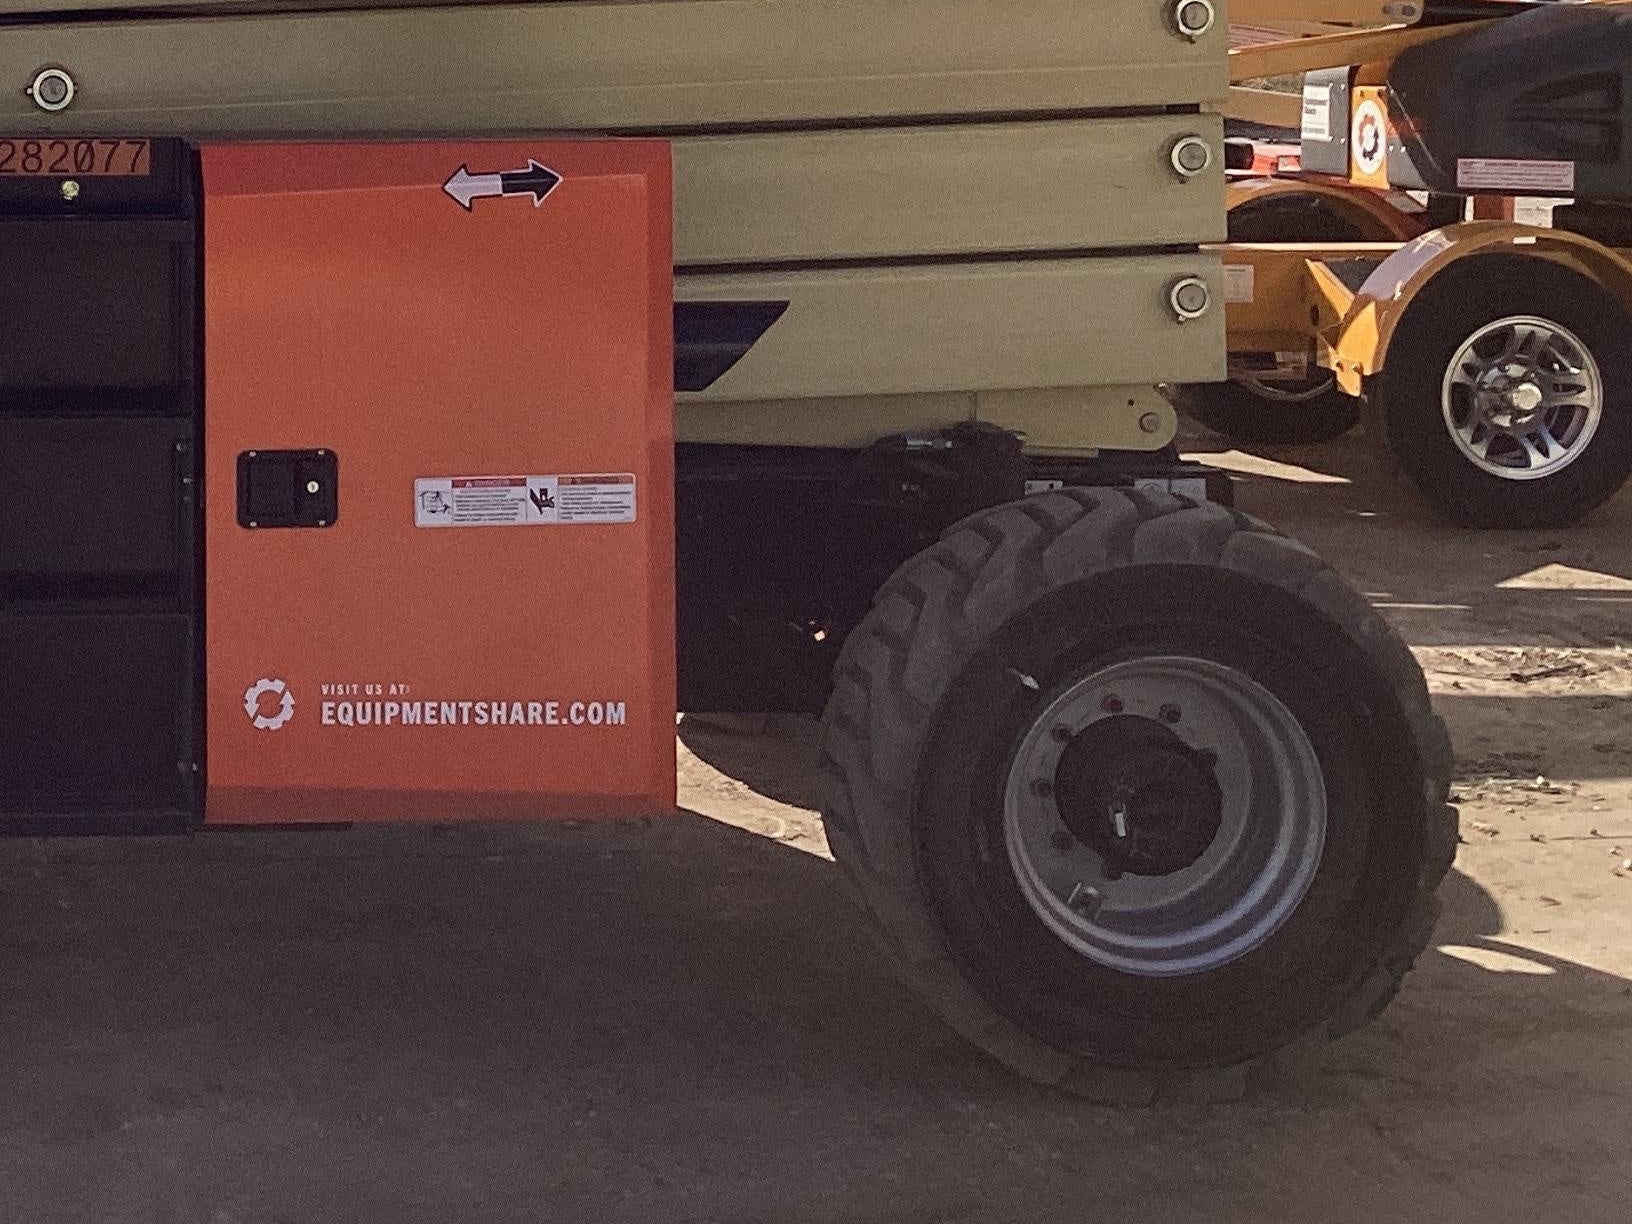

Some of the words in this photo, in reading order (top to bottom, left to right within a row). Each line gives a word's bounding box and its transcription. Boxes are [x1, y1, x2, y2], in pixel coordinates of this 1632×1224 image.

[321, 683, 360, 696] VISIT
[364, 683, 383, 695] US
[321, 701, 626, 727] EQUIPMENTSHARE.COM
